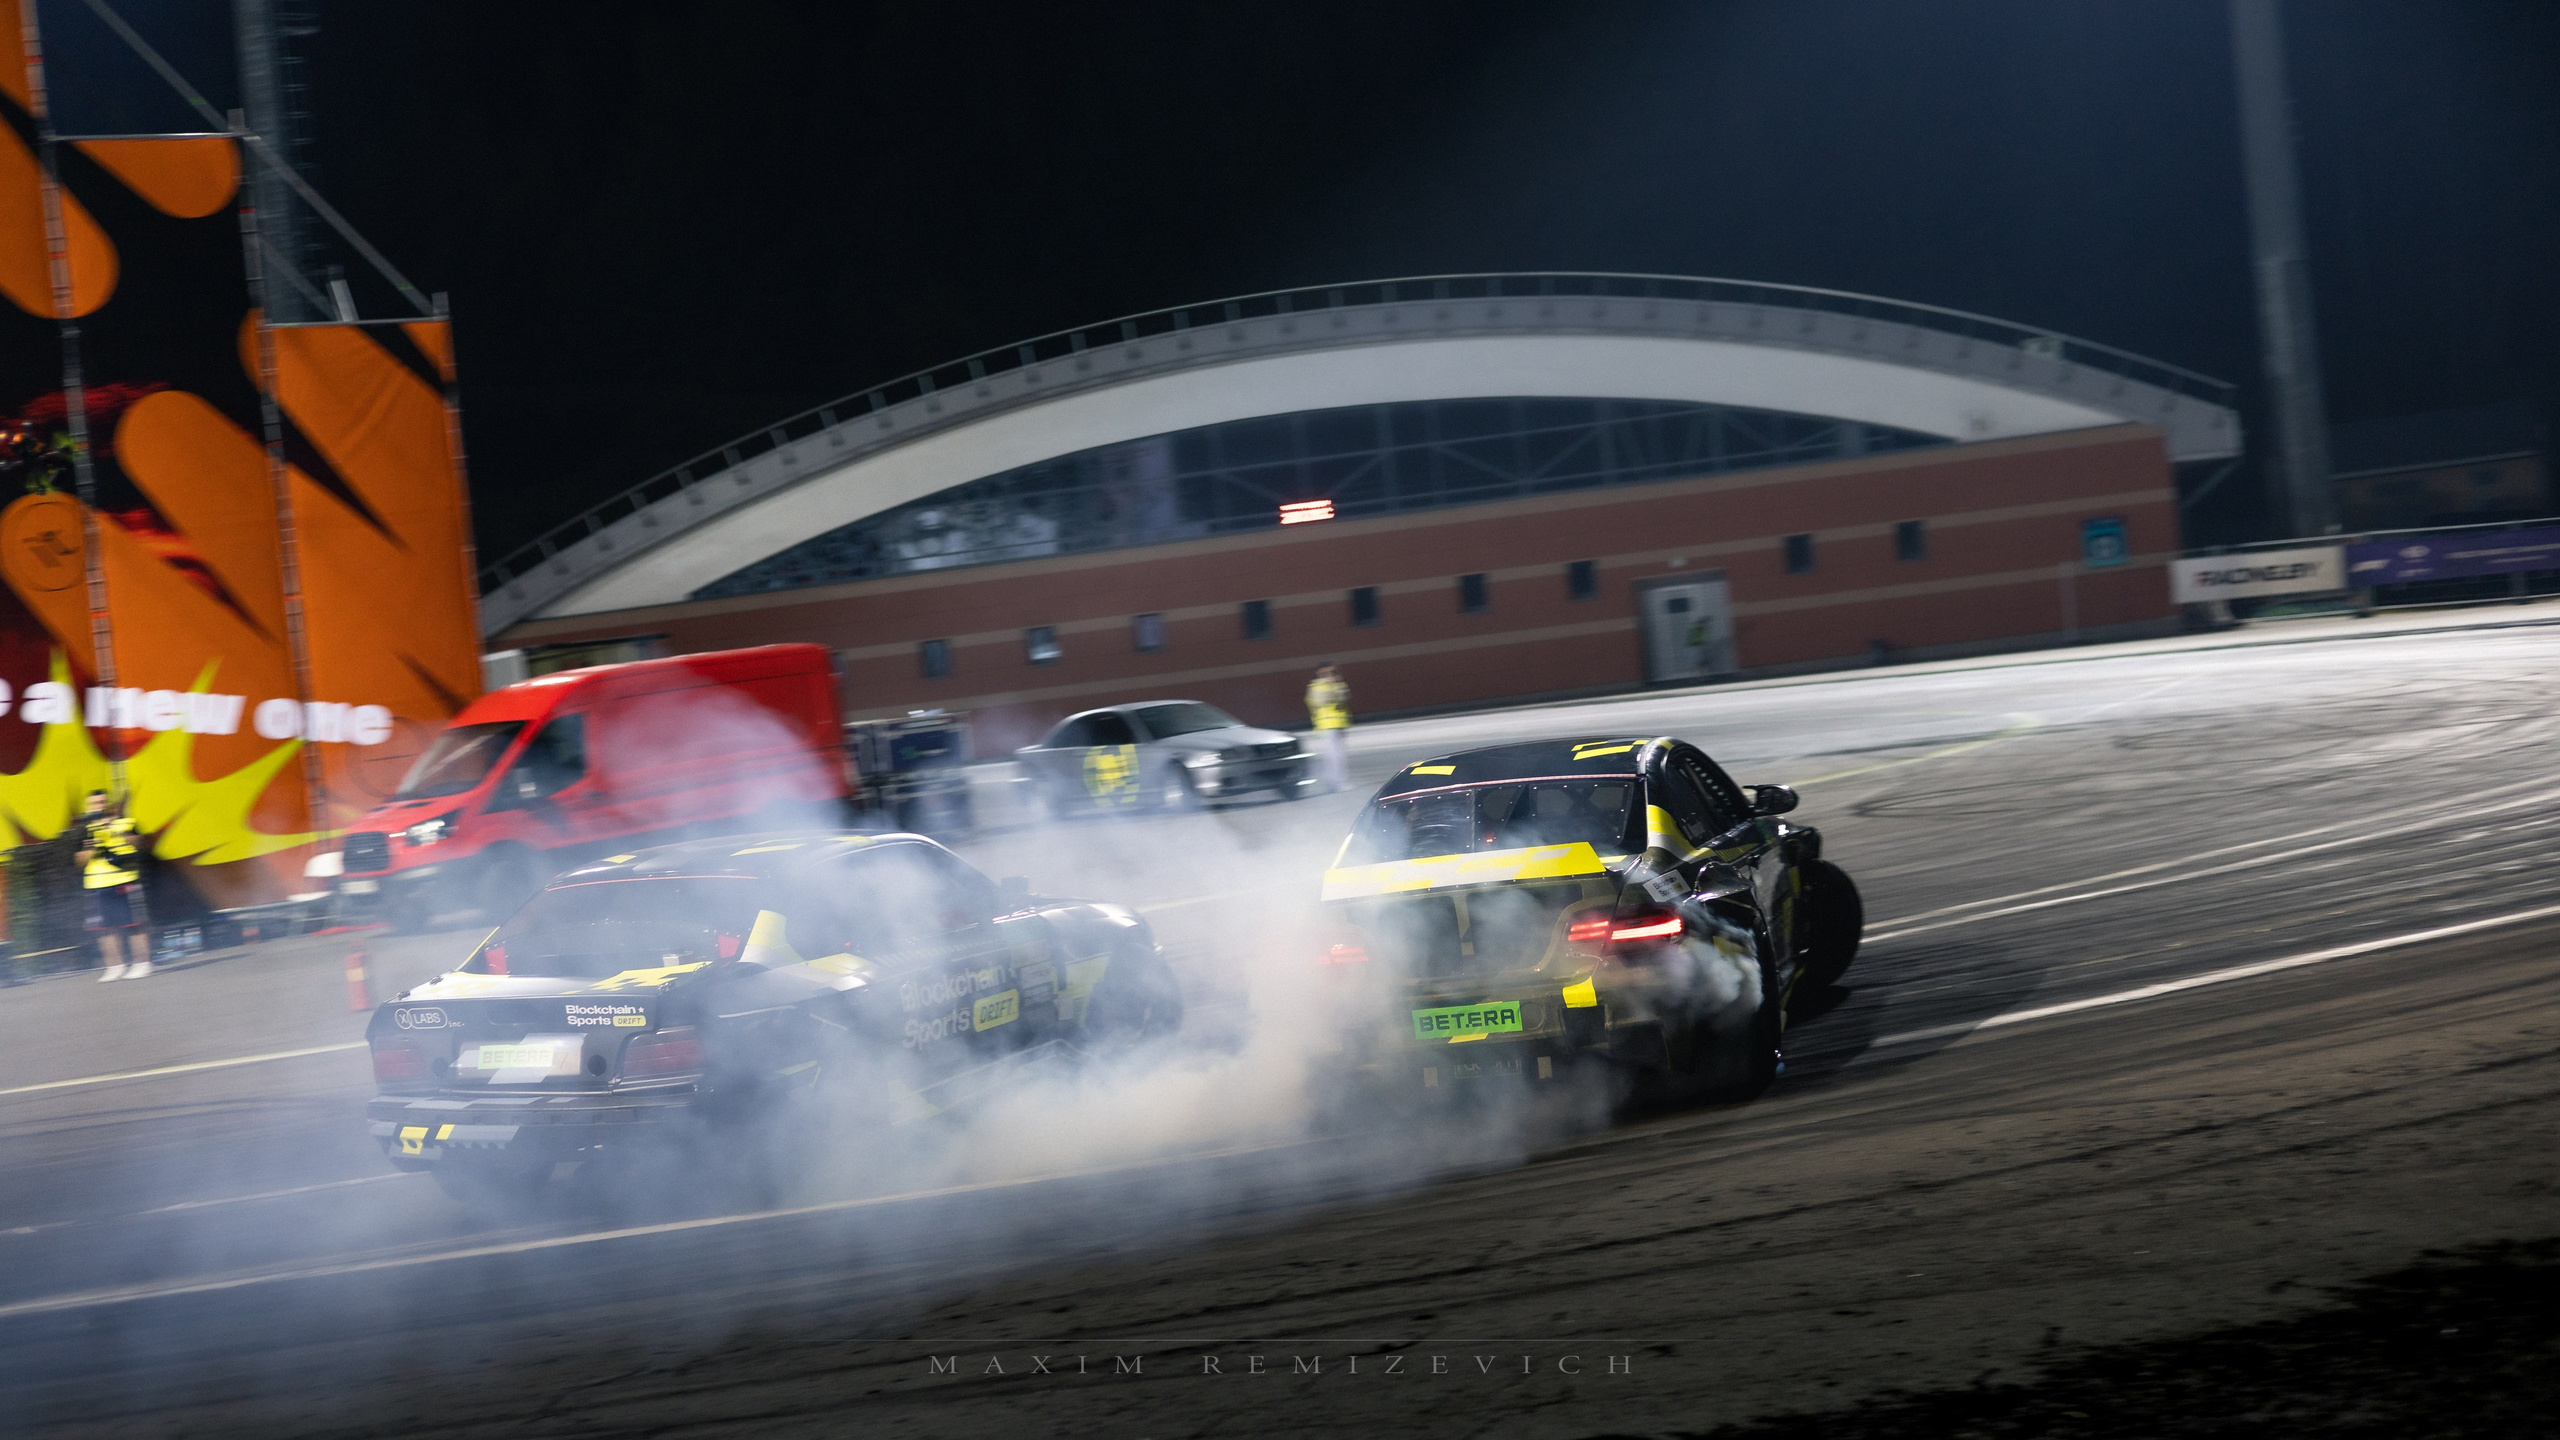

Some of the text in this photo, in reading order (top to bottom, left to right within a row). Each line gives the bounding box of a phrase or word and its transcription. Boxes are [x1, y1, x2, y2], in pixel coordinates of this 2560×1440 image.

[20, 681, 76, 725] a
[84, 686, 247, 736] new
[252, 698, 394, 746] one
[900, 965, 1007, 1013] Blockchain
[413, 1012, 441, 1024] LABS
[565, 1004, 637, 1015] Blockchain
[567, 1015, 641, 1027] Sports DRIFT
[903, 996, 1014, 1050] Sports DRIFT
